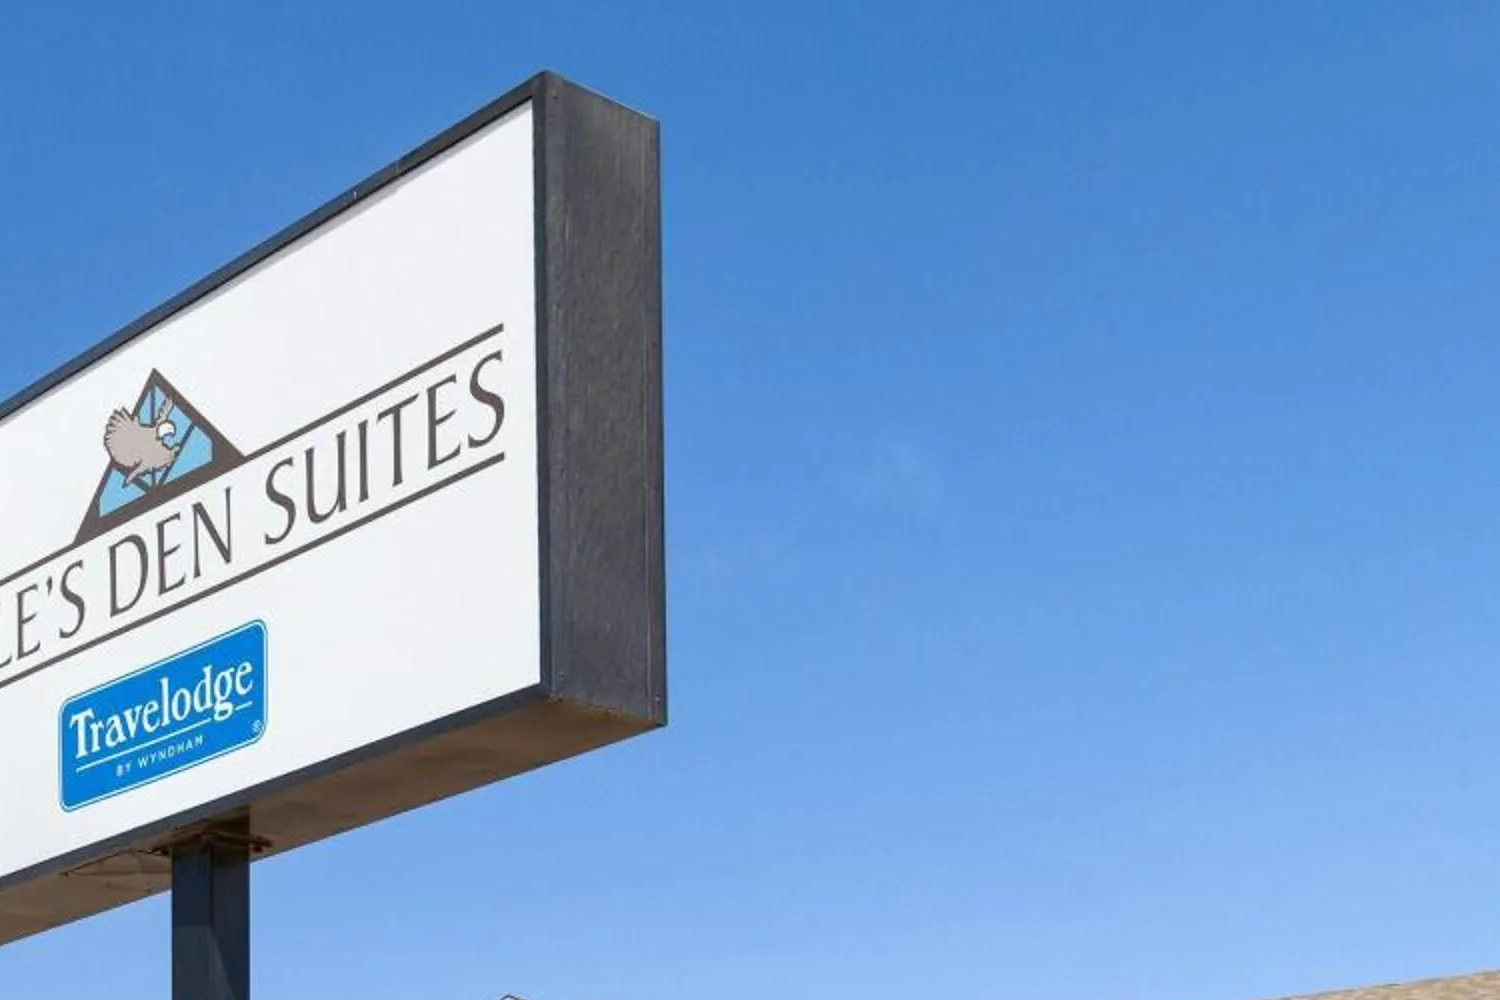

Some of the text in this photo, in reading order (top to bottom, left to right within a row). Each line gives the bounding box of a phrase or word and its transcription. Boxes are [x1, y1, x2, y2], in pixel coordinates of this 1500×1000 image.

[108, 486, 233, 617] DEN
[264, 350, 505, 545] SUITES
[69, 661, 253, 759] Travelodge
[115, 760, 132, 777] BY
